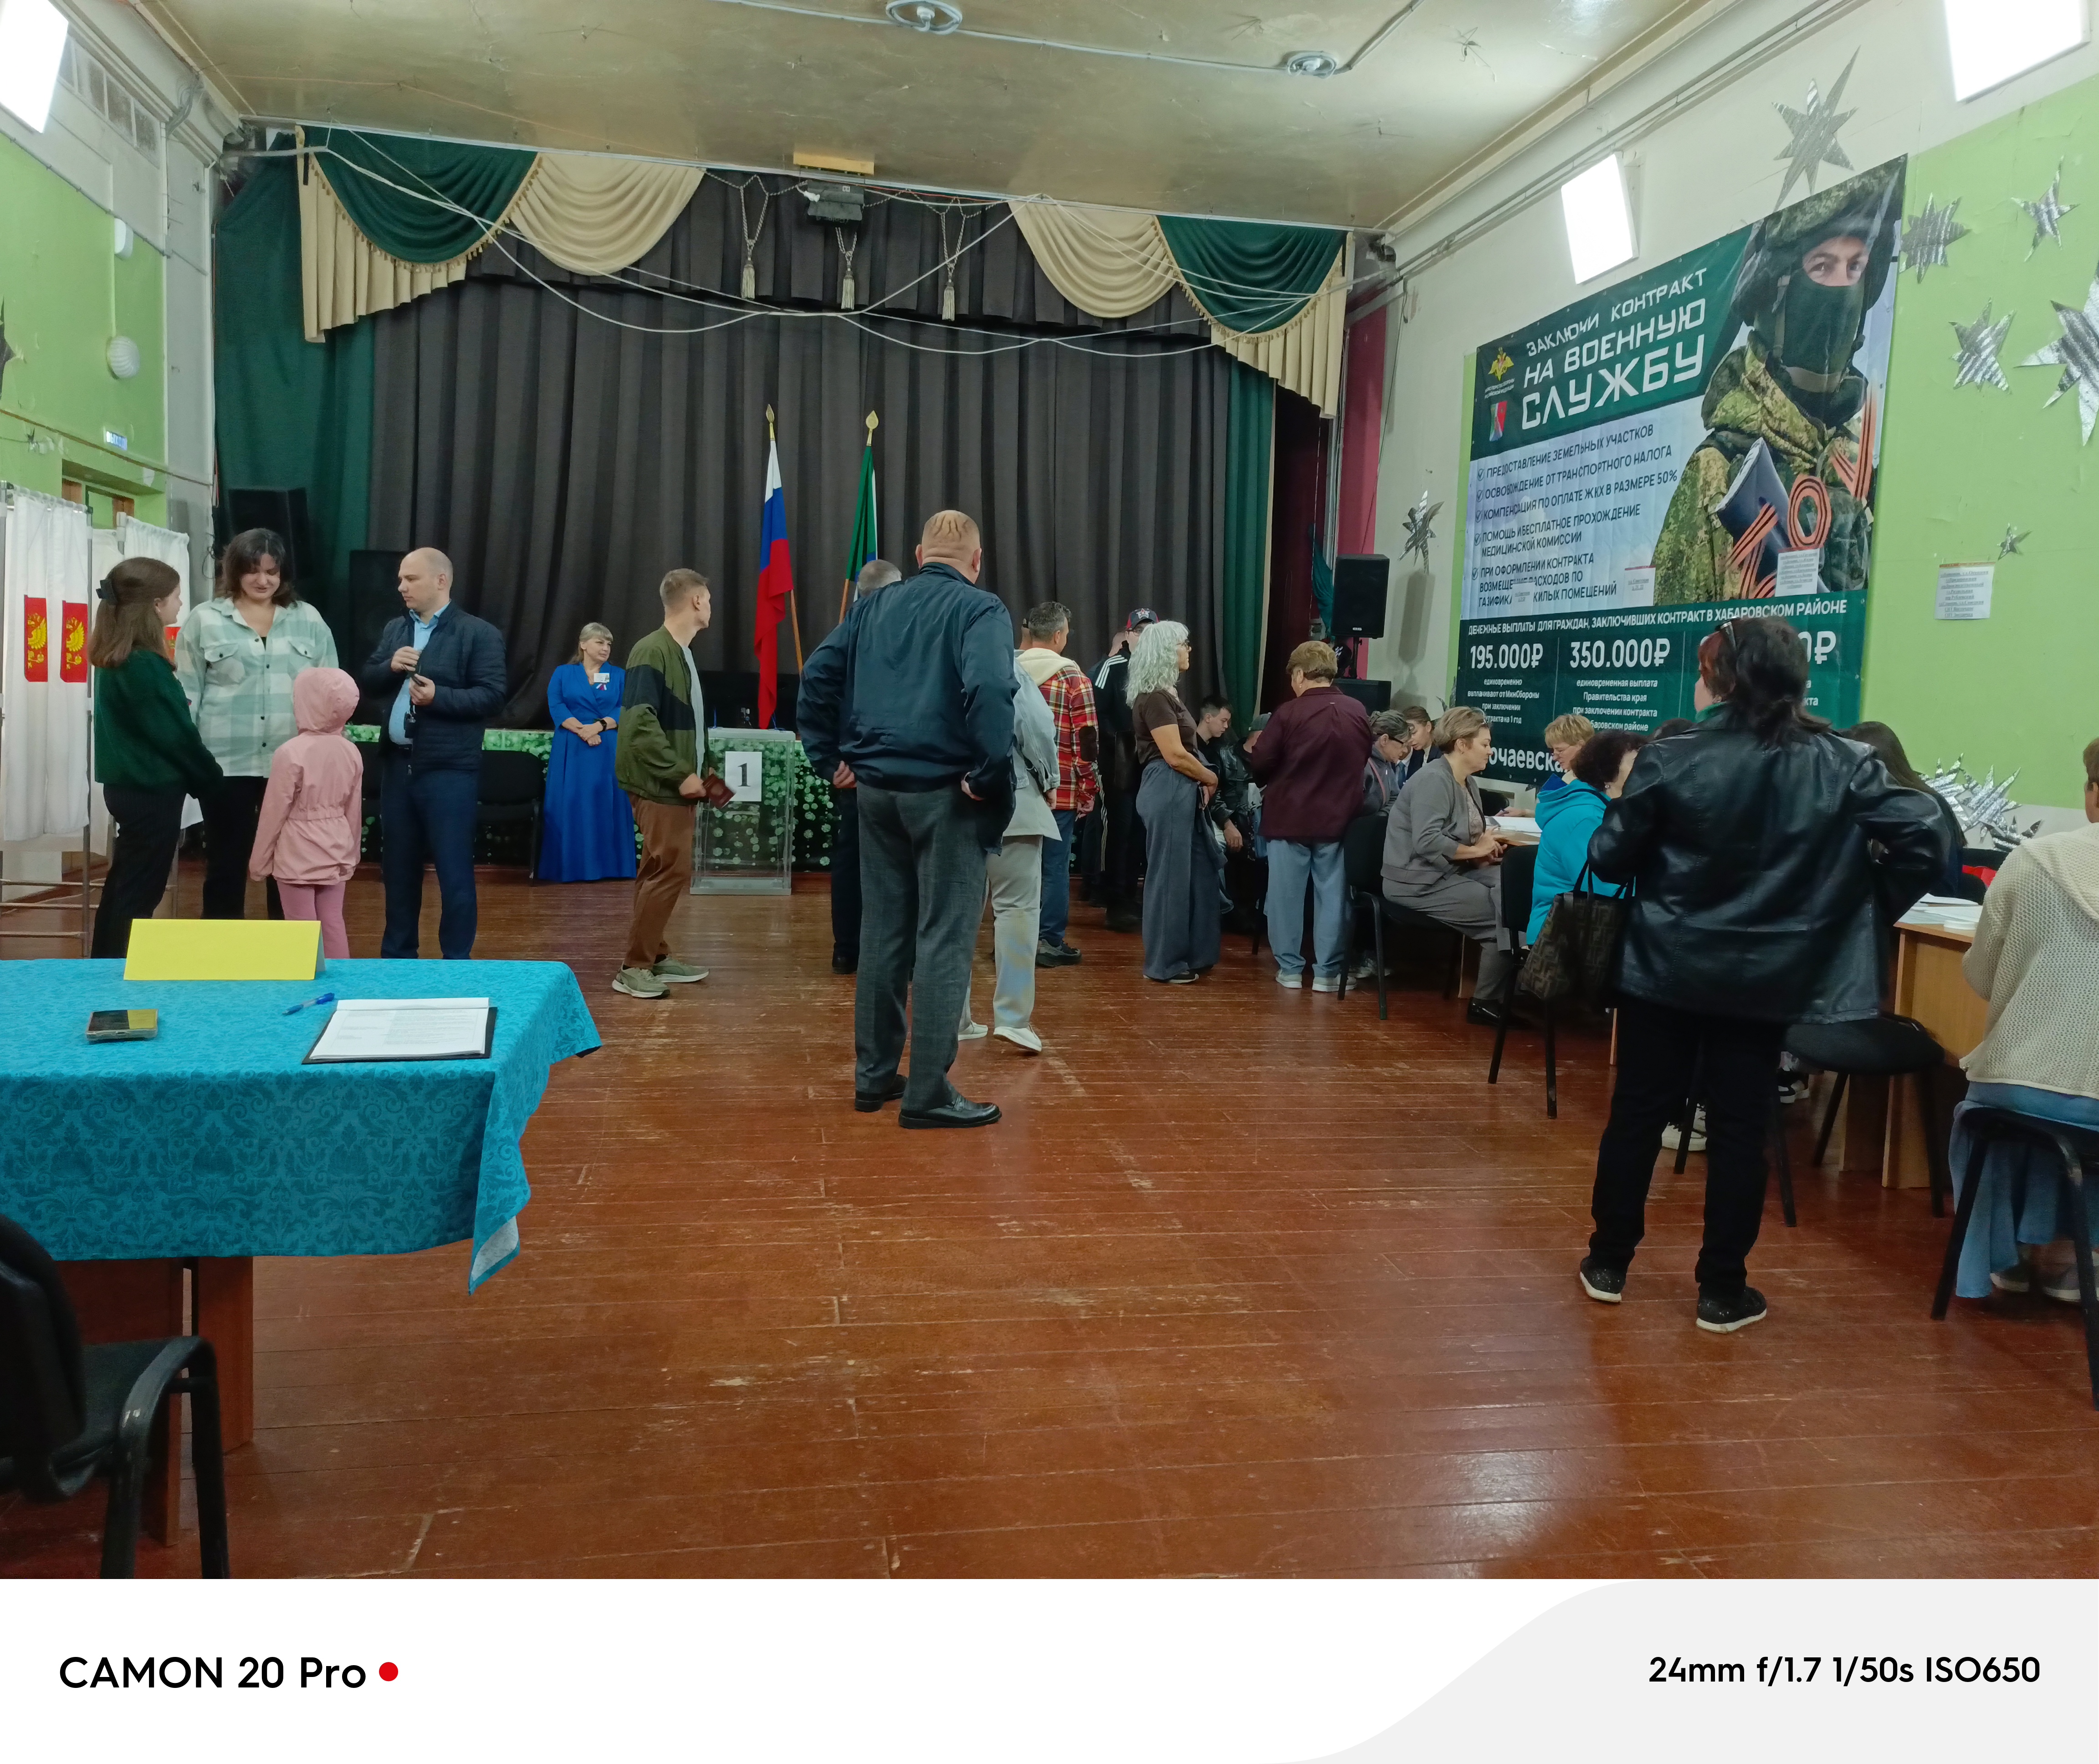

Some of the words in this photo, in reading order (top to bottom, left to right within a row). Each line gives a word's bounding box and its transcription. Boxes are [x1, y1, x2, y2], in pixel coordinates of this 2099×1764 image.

[1527, 313, 1599, 356] ЗАКЛЮЧИ
[1611, 268, 1706, 322] КОНТРАКТ
[1524, 359, 1553, 388] НА
[1564, 298, 1705, 373] ВОЕННУЮ
[1522, 334, 1705, 430] СЛУЖБУ
[1487, 452, 1551, 478] ПРЕДОСТАВЛЕНИЕ
[1553, 437, 1604, 461] ЗЕМЕЛЬНЫХ
[1606, 424, 1653, 447] УЧАСТКОВ
[1485, 476, 1543, 499] ОСВОБОЖДЕНИЕ
[1546, 473, 1556, 485] ОТ
[1557, 455, 1632, 481] ТРАНСПОРТНОГО
[1634, 445, 1672, 465] НАЛОГА
[1484, 499, 1536, 520] КОМПЕНСАЦИЯ
[1538, 497, 1550, 509] ПО
[1551, 489, 1583, 507] ОПЛАТЕ
[1584, 485, 1604, 499] ЖКХ
[1606, 484, 1611, 495] В
[1614, 474, 1655, 494] РАЗМЕРЕ
[1657, 469, 1677, 485] 50%
[1483, 528, 1515, 542] ПОМОЩЬ
[1517, 527, 1521, 537] И
[1522, 517, 1571, 536] БЕСПЛАТНОЕ
[1573, 504, 1641, 526] ПРОХОЖДЕНИЕ
[1482, 537, 1535, 557] МЕДИЦИНСКОЙ
[1536, 531, 1582, 549] КОМИССИИ
[1480, 567, 1493, 578] ПРИ
[1495, 559, 1545, 576] ОФОРМЛЕНИИ
[1547, 553, 1594, 569] КОНТРАКТА
[1572, 571, 1583, 582] ПО
[1561, 580, 1617, 600] ПОМЕЩЕНИЙ
[1468, 623, 1501, 636] ДЕНЕЖНЫЕ
[1502, 621, 1536, 633] ВЫПЛАТЫ
[1537, 620, 1553, 632] ДЛЯ
[1553, 618, 1590, 631] ГРАЖДАН,
[1591, 613, 1656, 628] ЗАКЛЮЧИВШИХ
[1657, 610, 1706, 624] КОНТРАКТ
[1707, 610, 1713, 621] В
[1714, 603, 1794, 621] ХАБАРОВСКОМ
[1796, 598, 1848, 616] РАЙОНЕ
[1470, 643, 1543, 669] 195.000₽
[1570, 638, 1670, 668] 350.000₽
[1484, 679, 1522, 687] единовременно
[1505, 690, 1540, 700] МинОбороны
[1577, 679, 1628, 688] единовременная
[1583, 692, 1630, 702] Правительства
[1632, 694, 1647, 704] края
[1573, 707, 1584, 715] при
[1623, 708, 1658, 718] контракта
[1590, 720, 1623, 730] баровском
[1624, 721, 1648, 731] районе
[737, 763, 751, 787] 1
